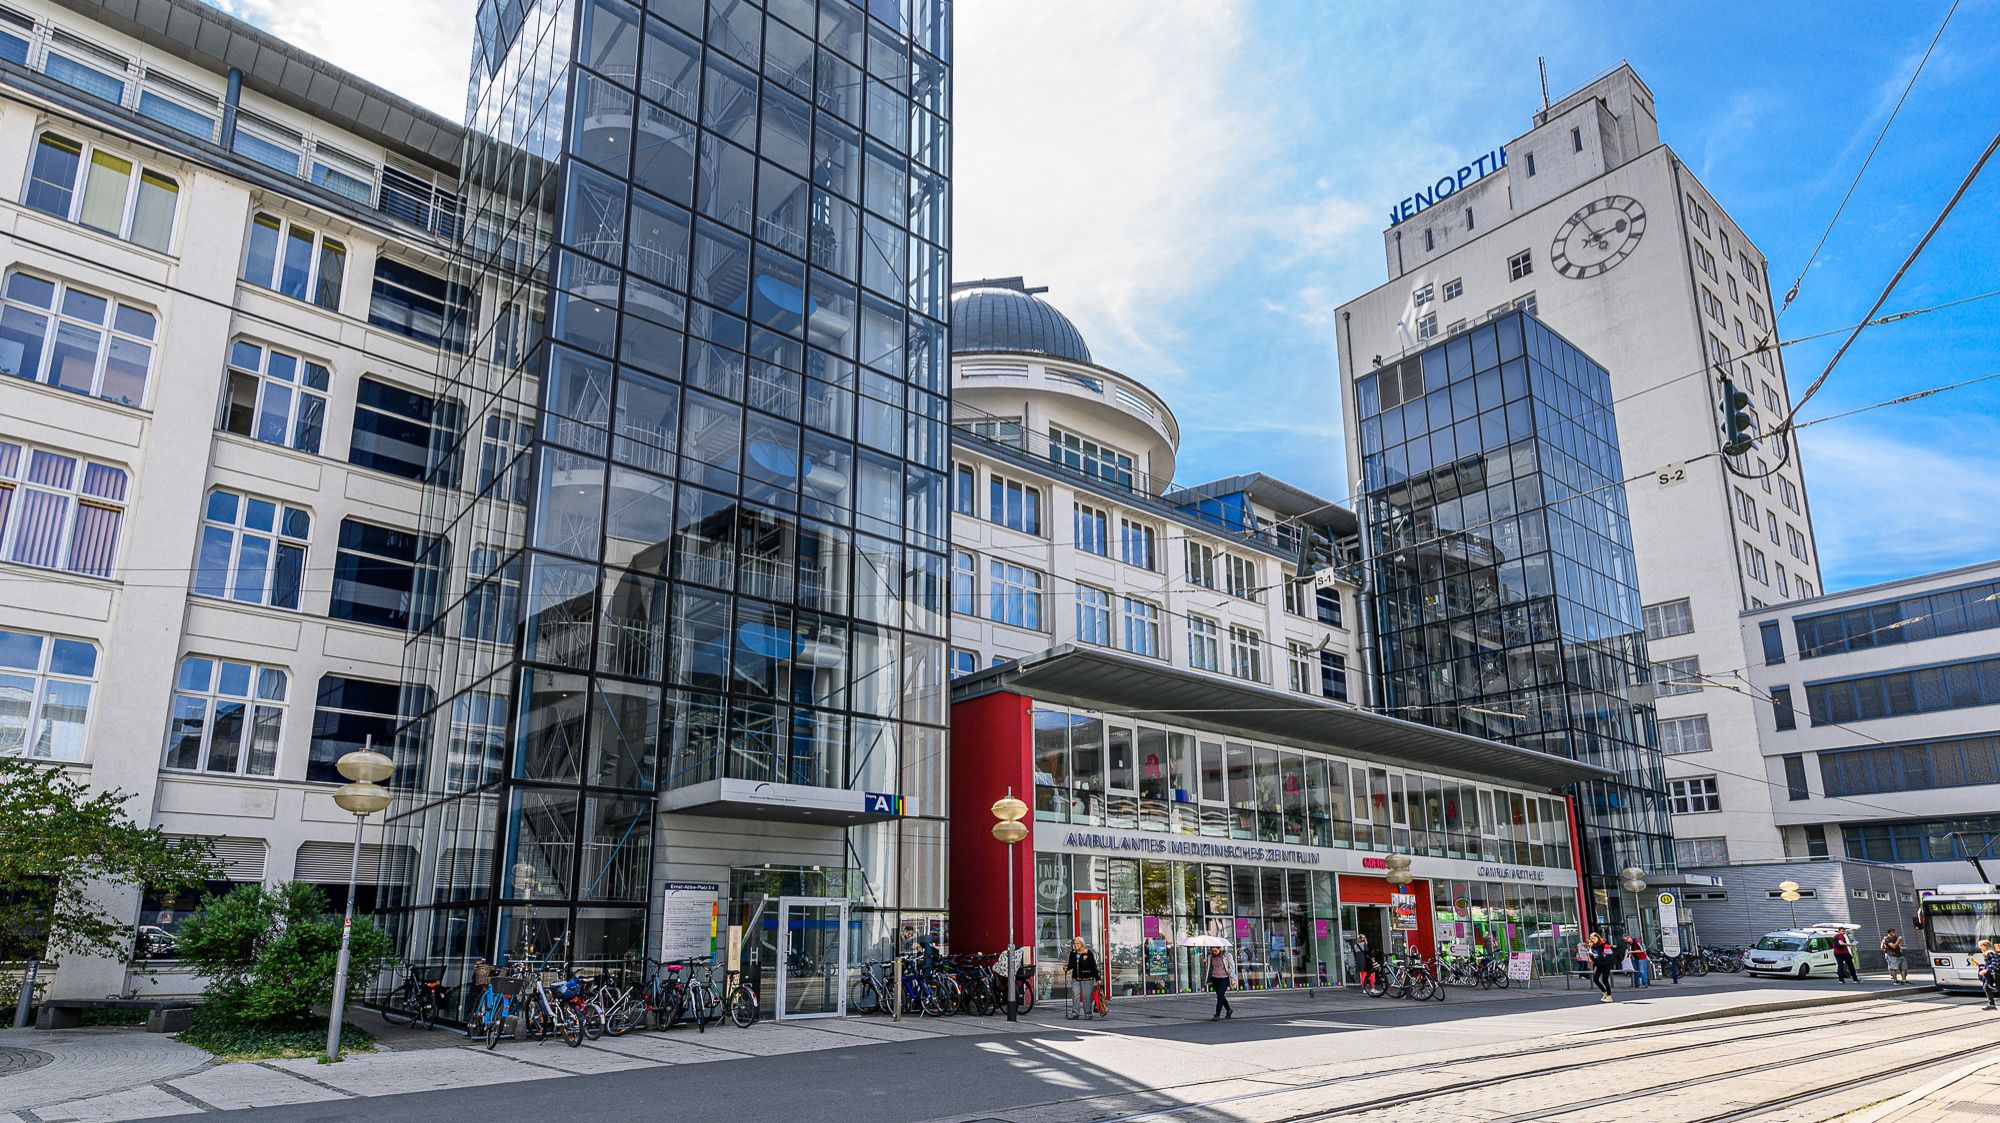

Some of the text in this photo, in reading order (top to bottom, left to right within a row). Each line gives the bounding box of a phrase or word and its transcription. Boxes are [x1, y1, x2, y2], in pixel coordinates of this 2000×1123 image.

[1659, 470, 1684, 484] S-2
[1317, 575, 1332, 585] S-1
[874, 796, 890, 812] A
[1065, 832, 1320, 864] AMBULANTES MEDIZINISCHES ZENTRUM
